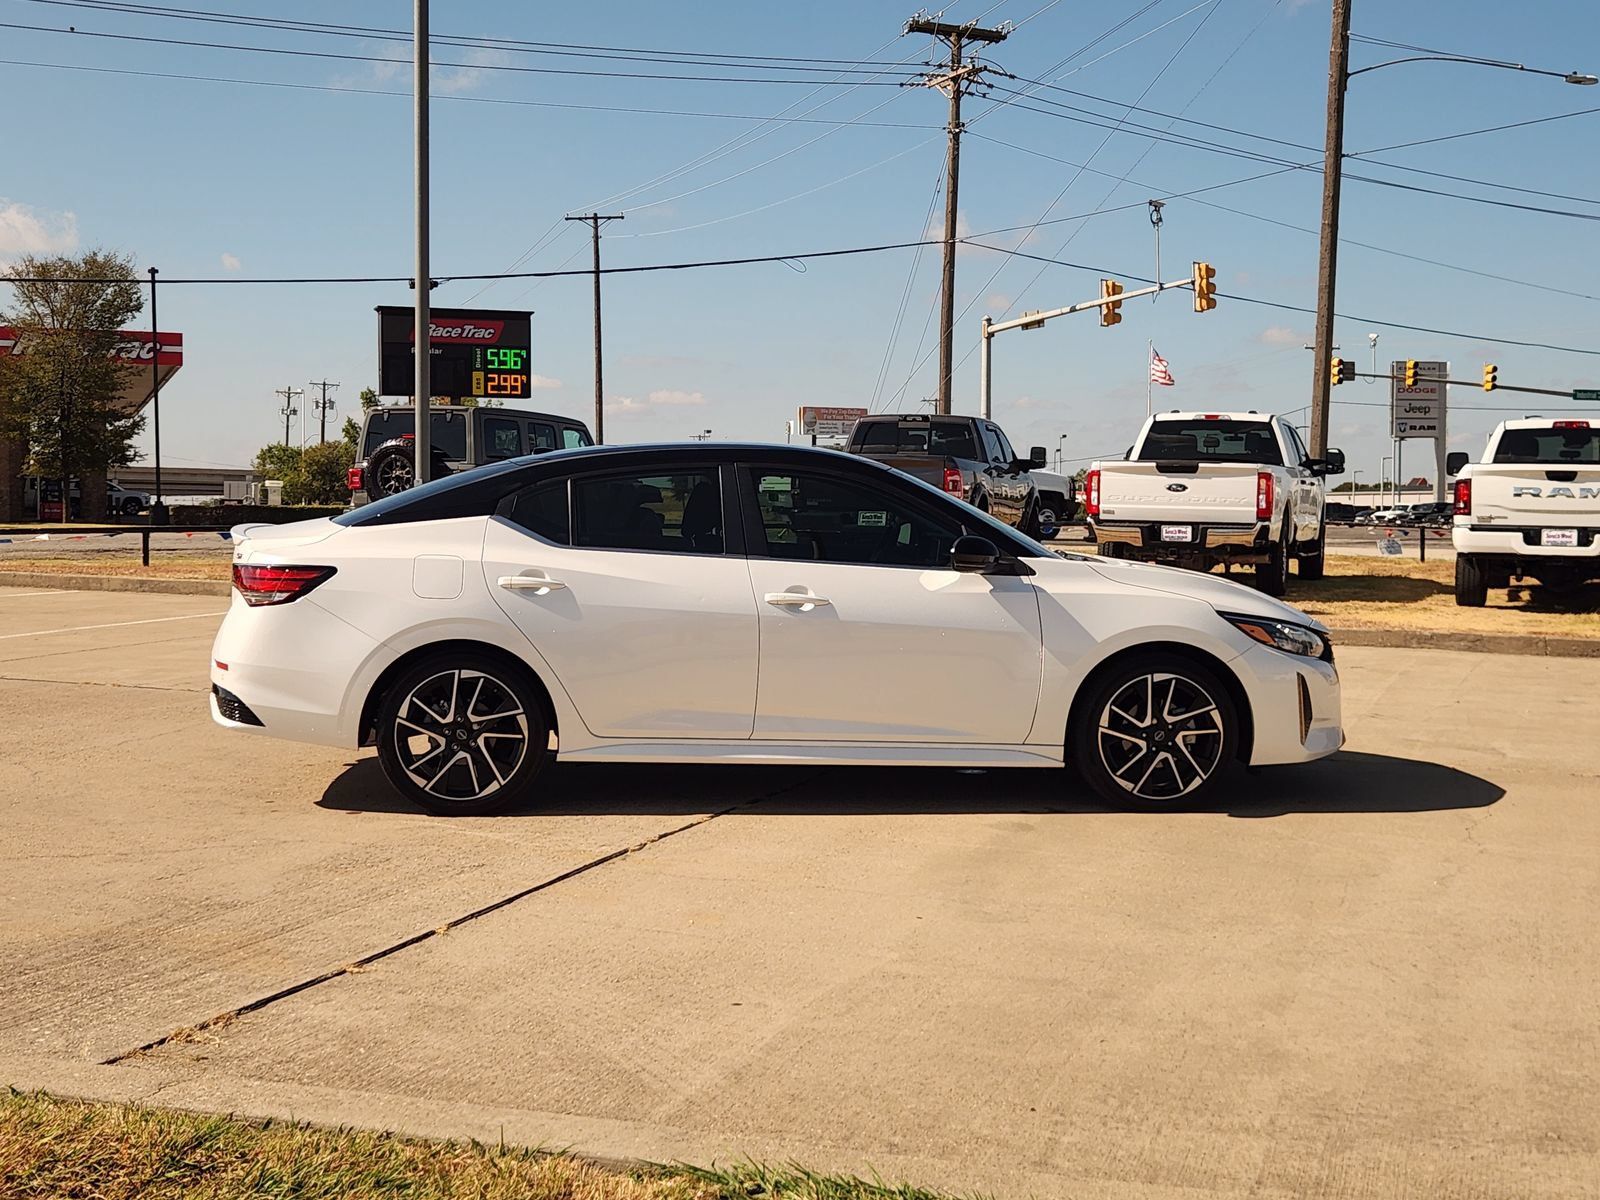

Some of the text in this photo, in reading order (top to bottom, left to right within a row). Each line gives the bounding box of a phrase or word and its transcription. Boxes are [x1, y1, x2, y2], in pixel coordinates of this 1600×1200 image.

[429, 324, 495, 338] RaceTrac
[1404, 403, 1431, 416] Jeep
[1409, 424, 1437, 432] RAM
[1513, 487, 1600, 498] RAM
